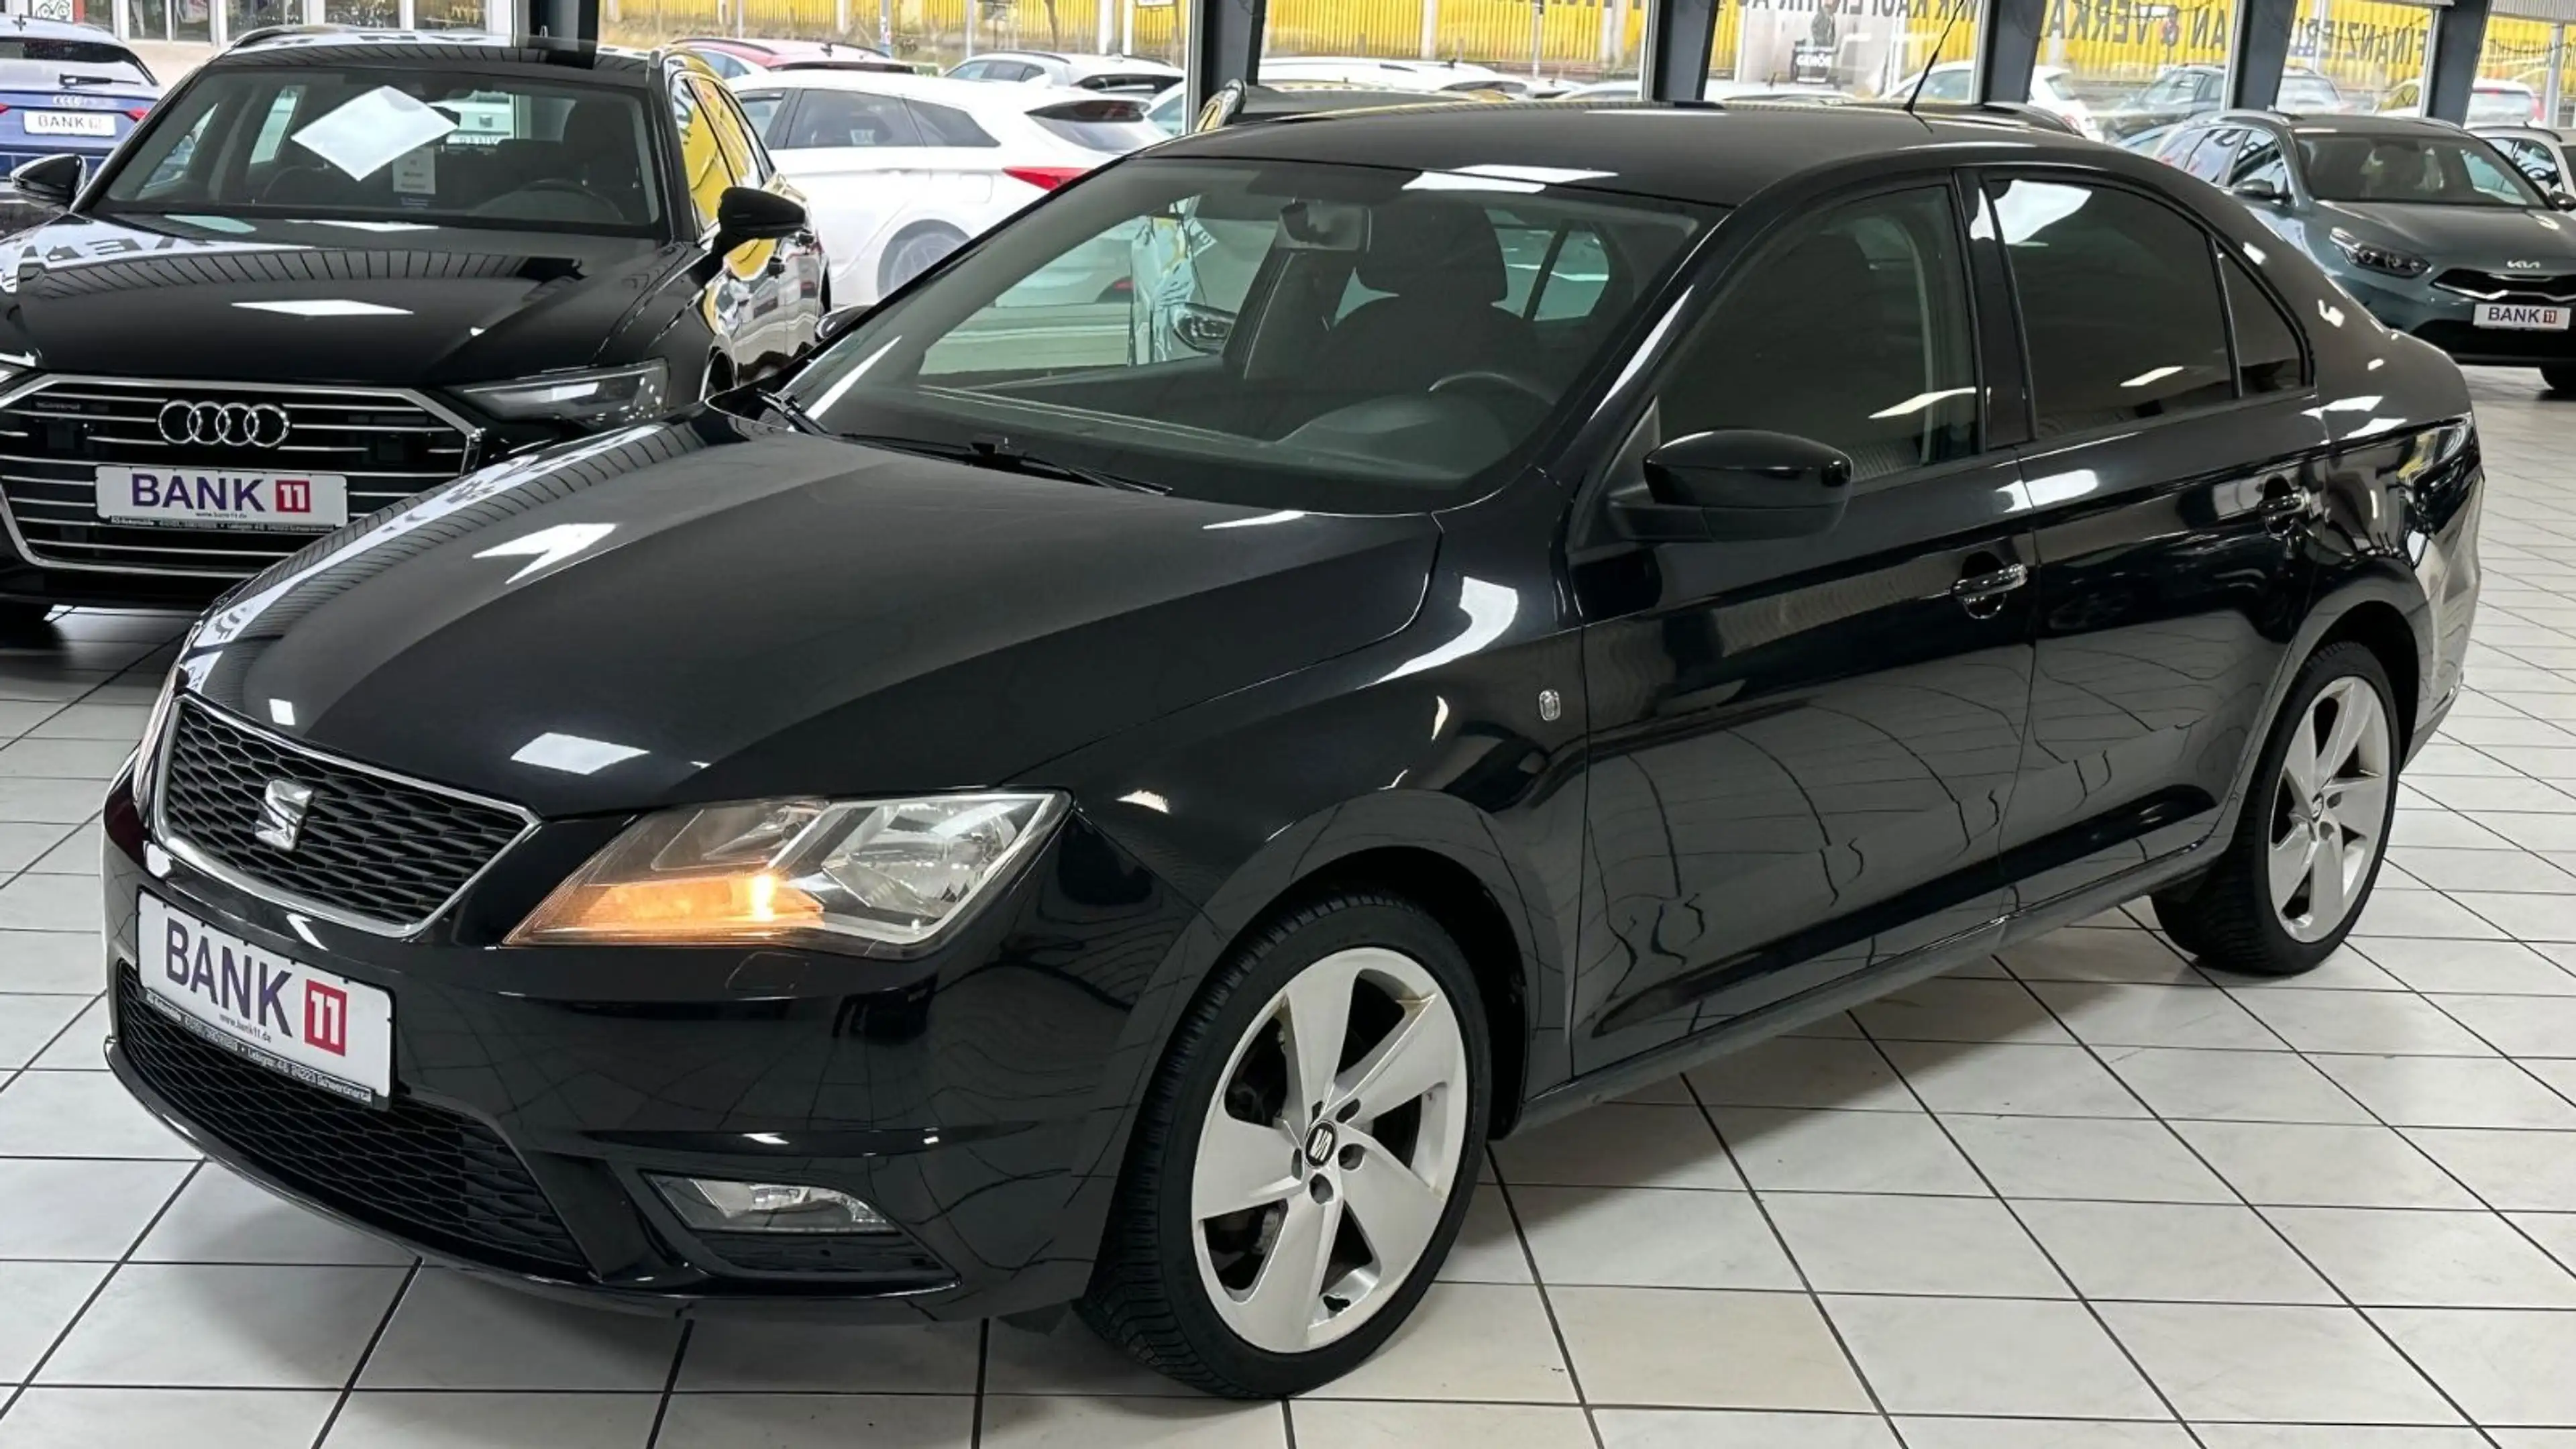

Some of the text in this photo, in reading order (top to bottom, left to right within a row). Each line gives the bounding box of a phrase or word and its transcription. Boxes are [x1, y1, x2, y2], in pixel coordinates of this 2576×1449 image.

[38, 115, 84, 128] BANK
[2488, 307, 2540, 323] BANK
[132, 474, 308, 512] BANK 11
[166, 917, 293, 1038] BANK
[309, 987, 342, 1048] 11
